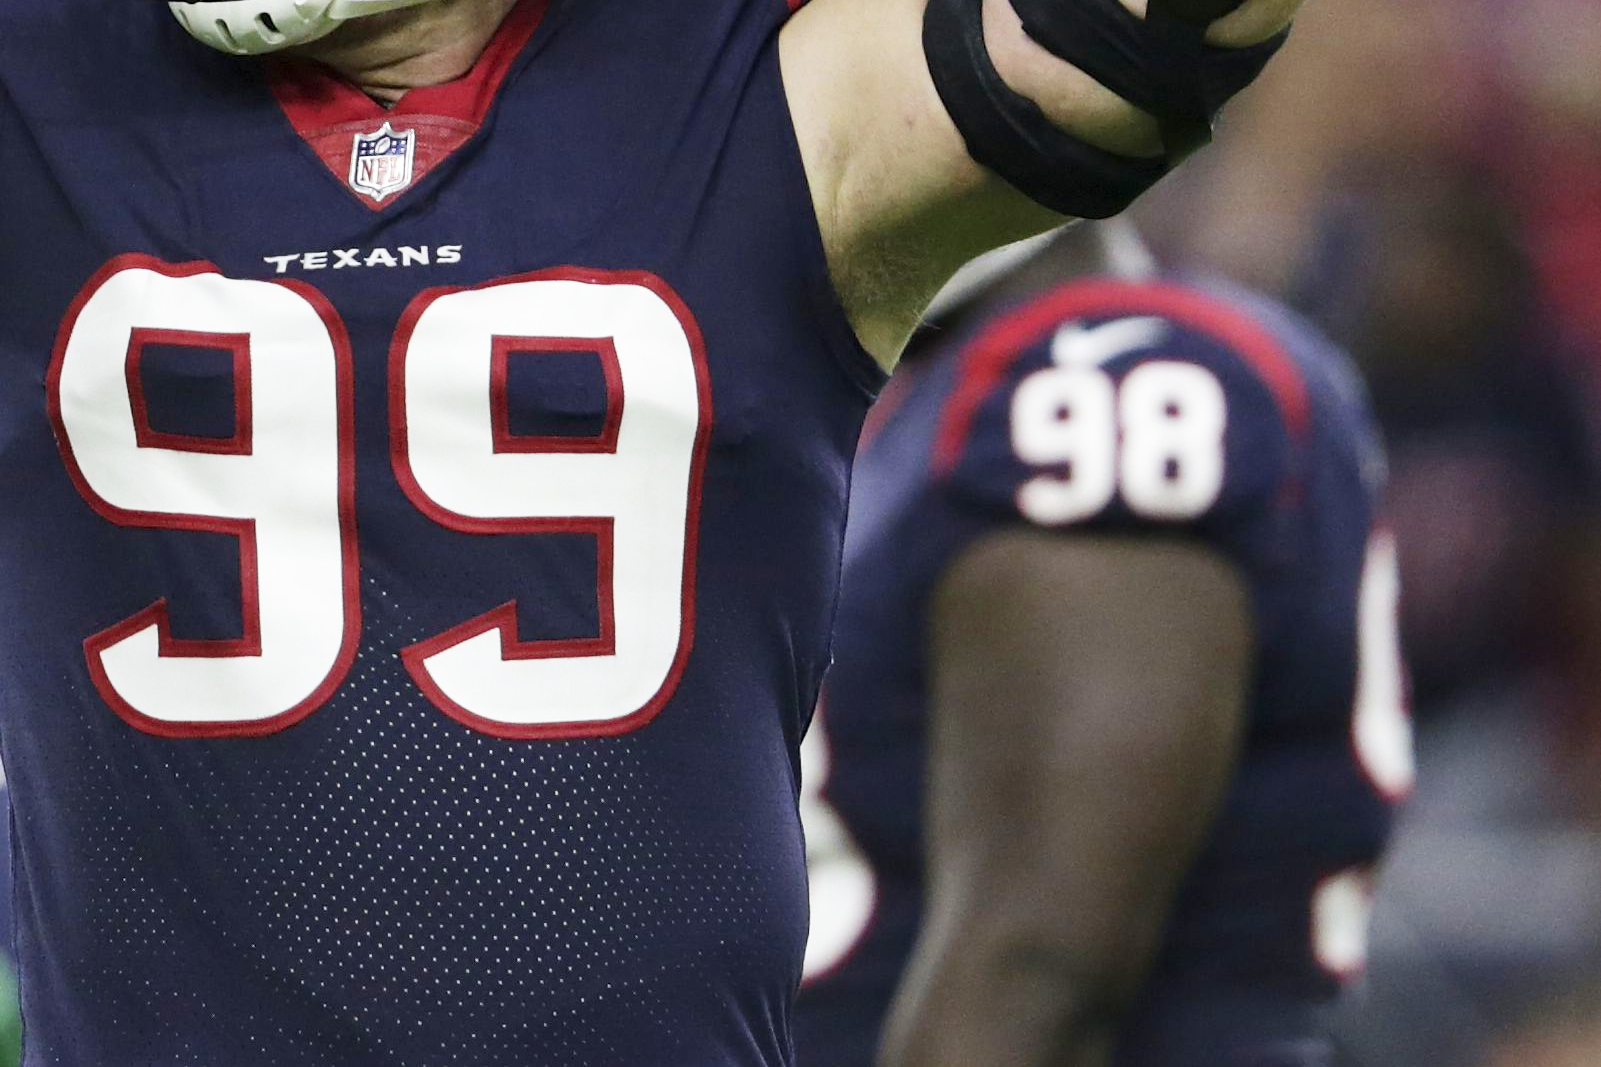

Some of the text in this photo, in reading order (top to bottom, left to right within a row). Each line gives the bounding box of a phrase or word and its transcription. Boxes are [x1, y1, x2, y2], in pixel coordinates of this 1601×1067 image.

[359, 156, 402, 183] NFL
[263, 244, 463, 274] TEXANS
[1010, 359, 1228, 526] 98
[47, 252, 713, 739] 99
